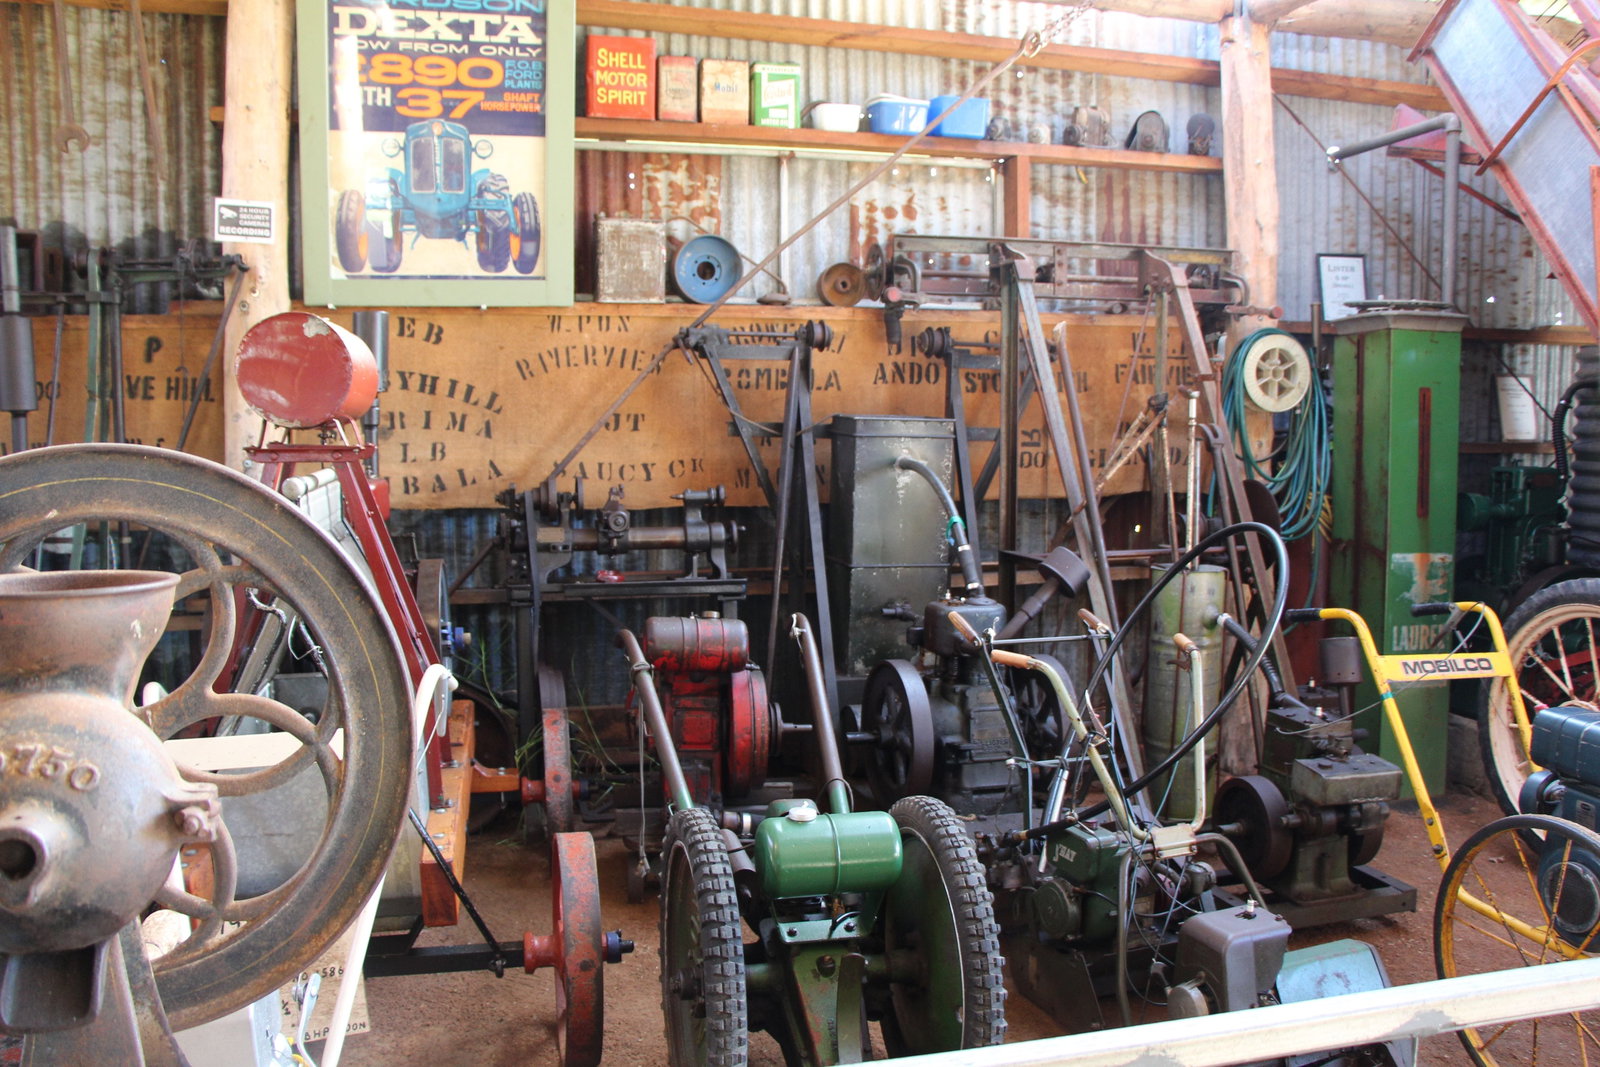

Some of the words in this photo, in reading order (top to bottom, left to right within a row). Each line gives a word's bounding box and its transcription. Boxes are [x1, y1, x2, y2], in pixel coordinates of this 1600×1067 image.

[333, 6, 542, 45] DEXTA
[399, 42, 468, 54] FROM
[480, 45, 542, 58] ONLY
[597, 48, 646, 69] SHELL
[505, 70, 542, 79] FORD
[596, 70, 647, 88] MOTOR
[505, 79, 543, 89] PLANTS
[396, 87, 485, 118] 37
[503, 92, 541, 102] SHAFT
[597, 88, 647, 105] SPIRIT
[480, 101, 541, 112] HORSEPOWER
[220, 226, 270, 237] RECORDING
[1402, 658, 1493, 675] MOBILCO
[15, 742, 101, 791] 750
